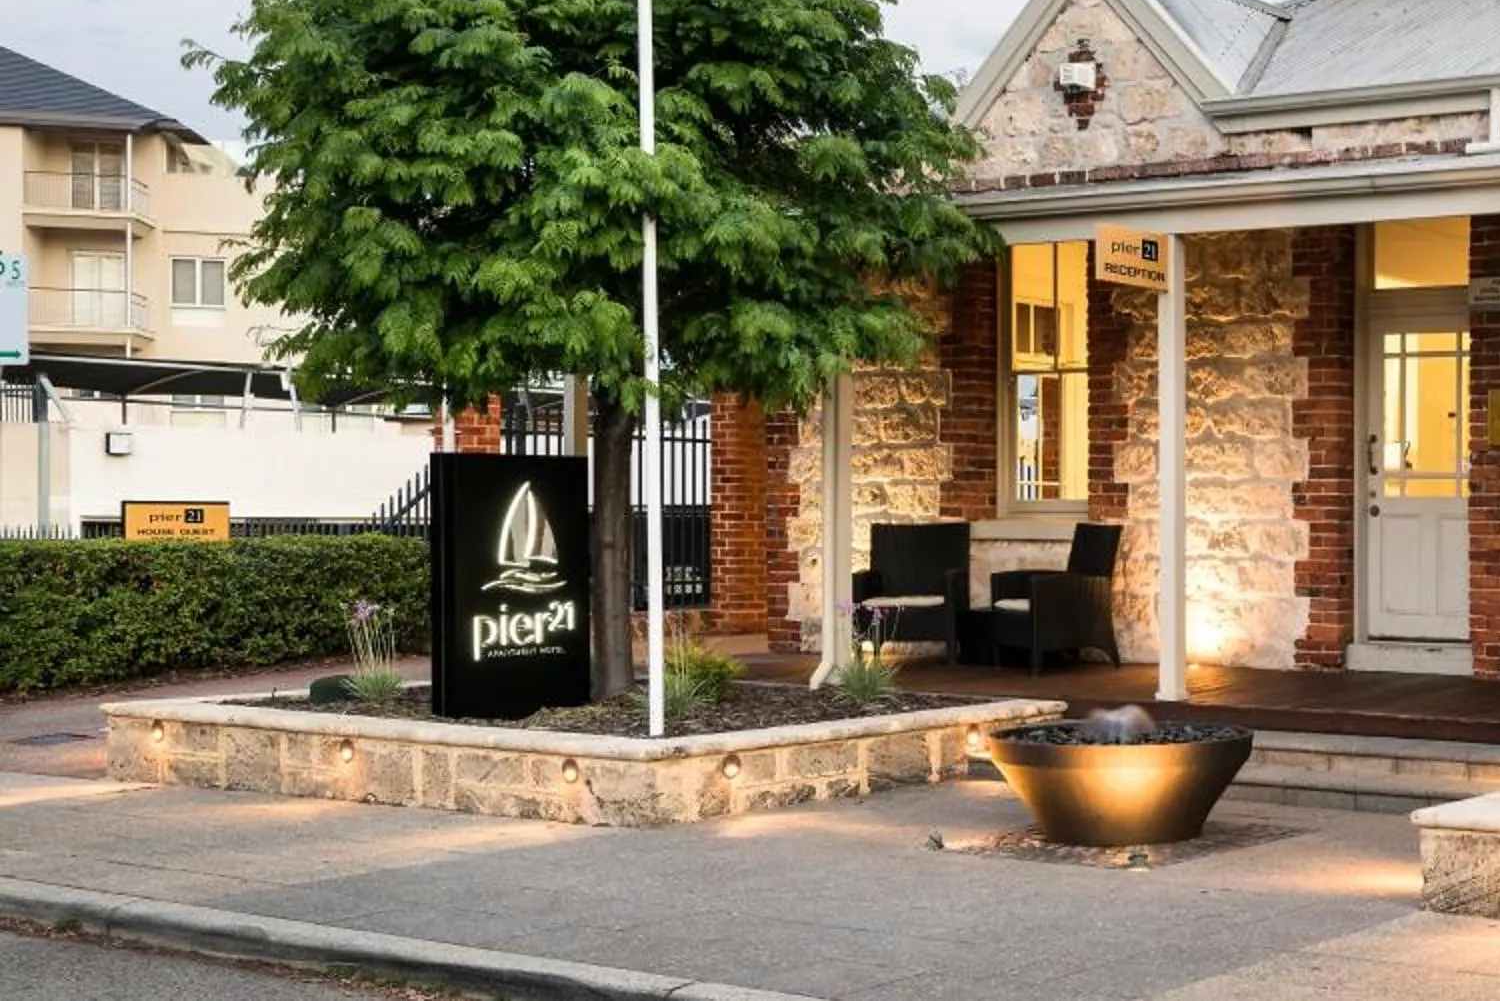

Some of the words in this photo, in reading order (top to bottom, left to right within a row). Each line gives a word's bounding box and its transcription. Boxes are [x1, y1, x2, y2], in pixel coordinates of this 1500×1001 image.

[1111, 241, 1141, 256] pier
[1143, 242, 1157, 259] 21
[1104, 263, 1165, 282] RECEPTION
[149, 513, 181, 524] pier
[185, 510, 201, 522] 21
